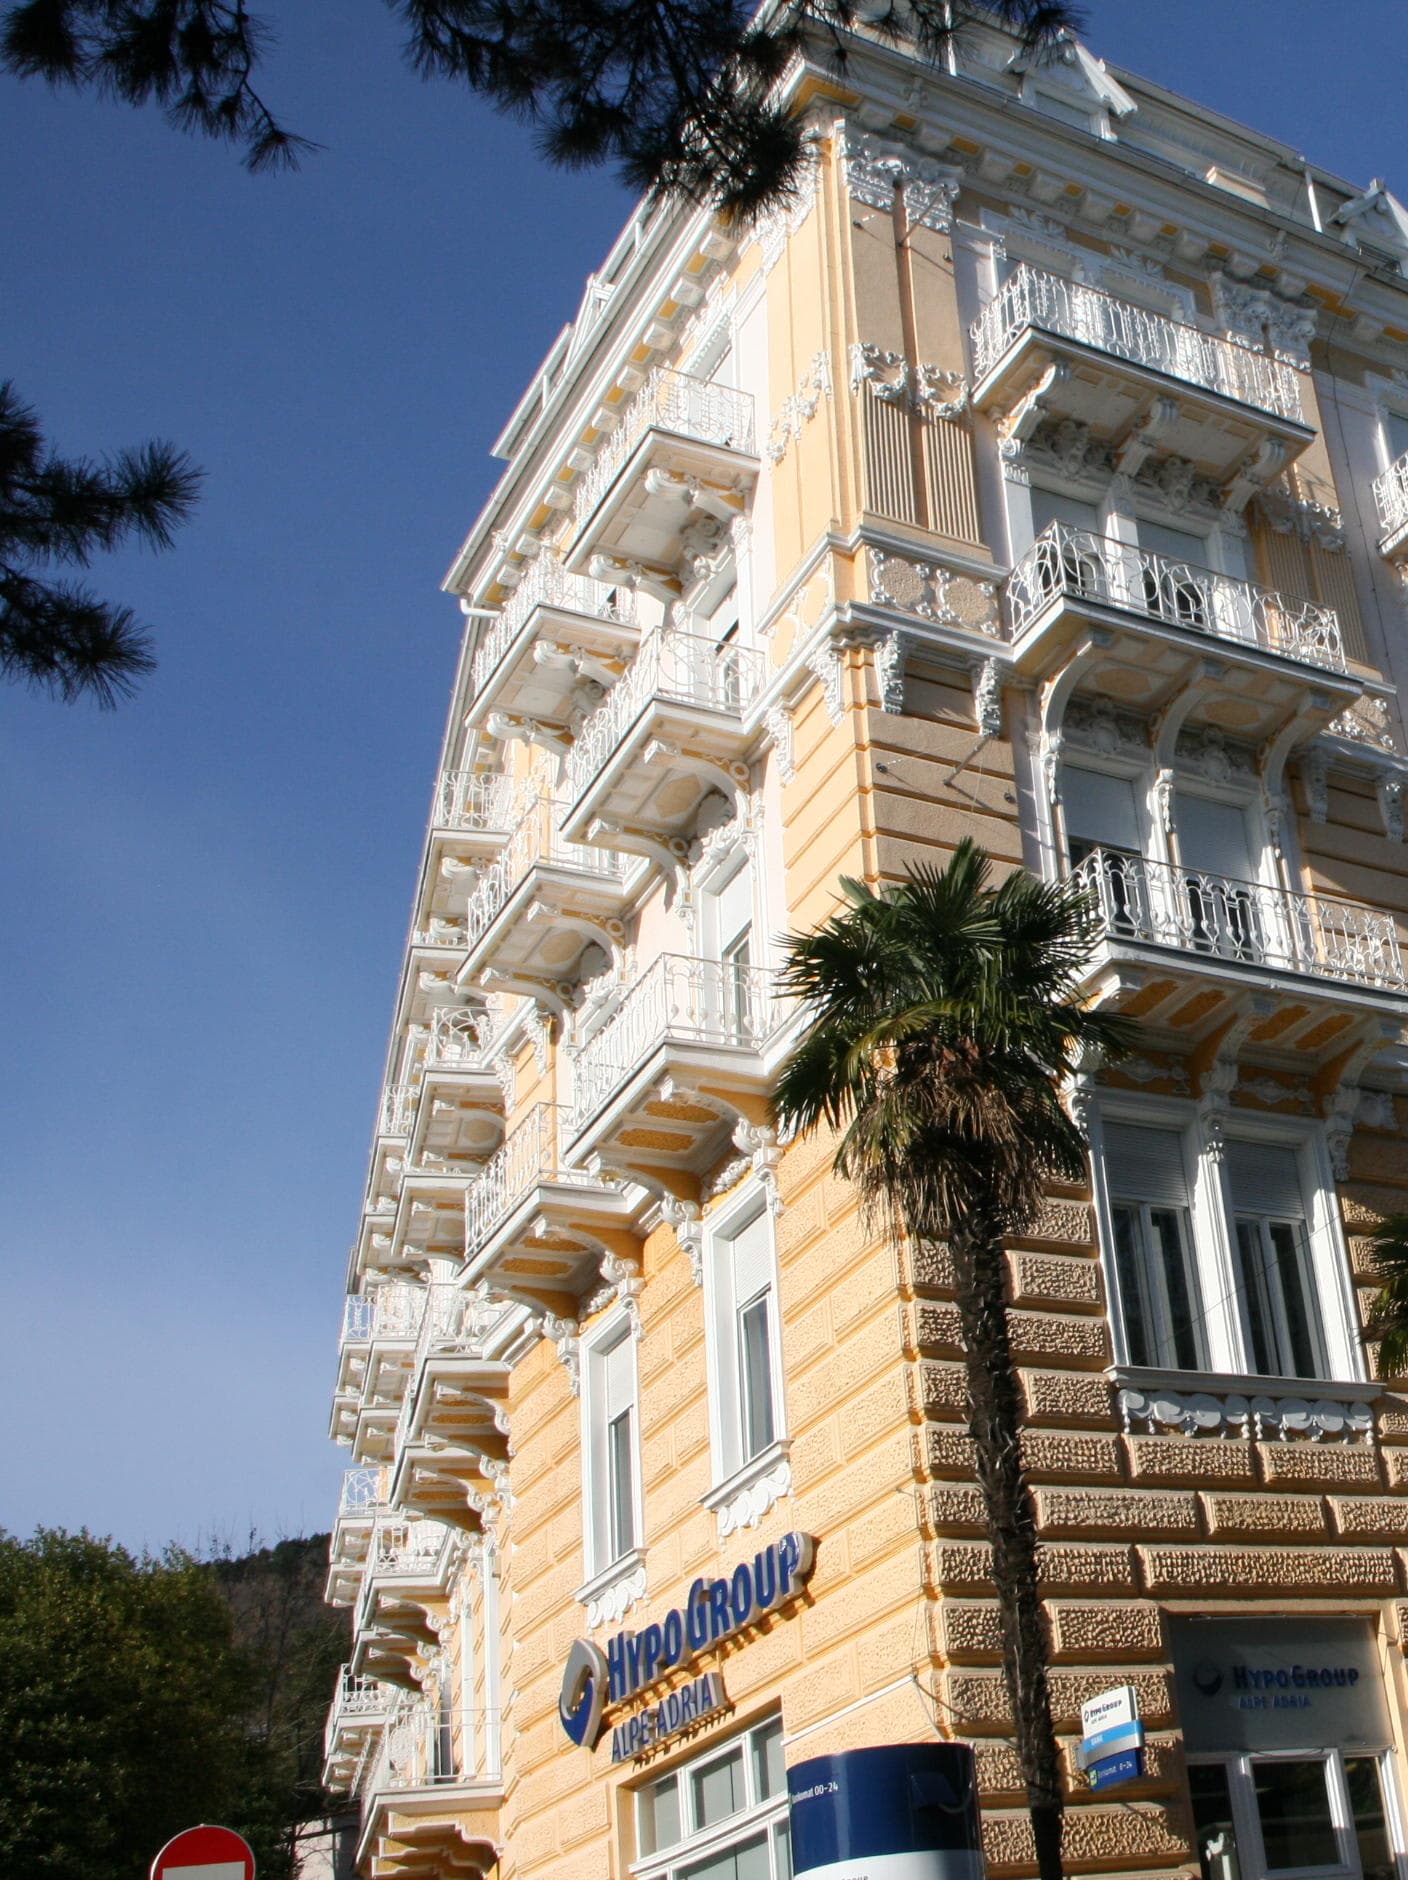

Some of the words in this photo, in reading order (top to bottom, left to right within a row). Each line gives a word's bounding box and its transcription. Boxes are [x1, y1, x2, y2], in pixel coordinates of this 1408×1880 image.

[612, 1708, 656, 1763] ALPE
[657, 1672, 722, 1738] ADRIA
[814, 1781, 839, 1796] 00-24
